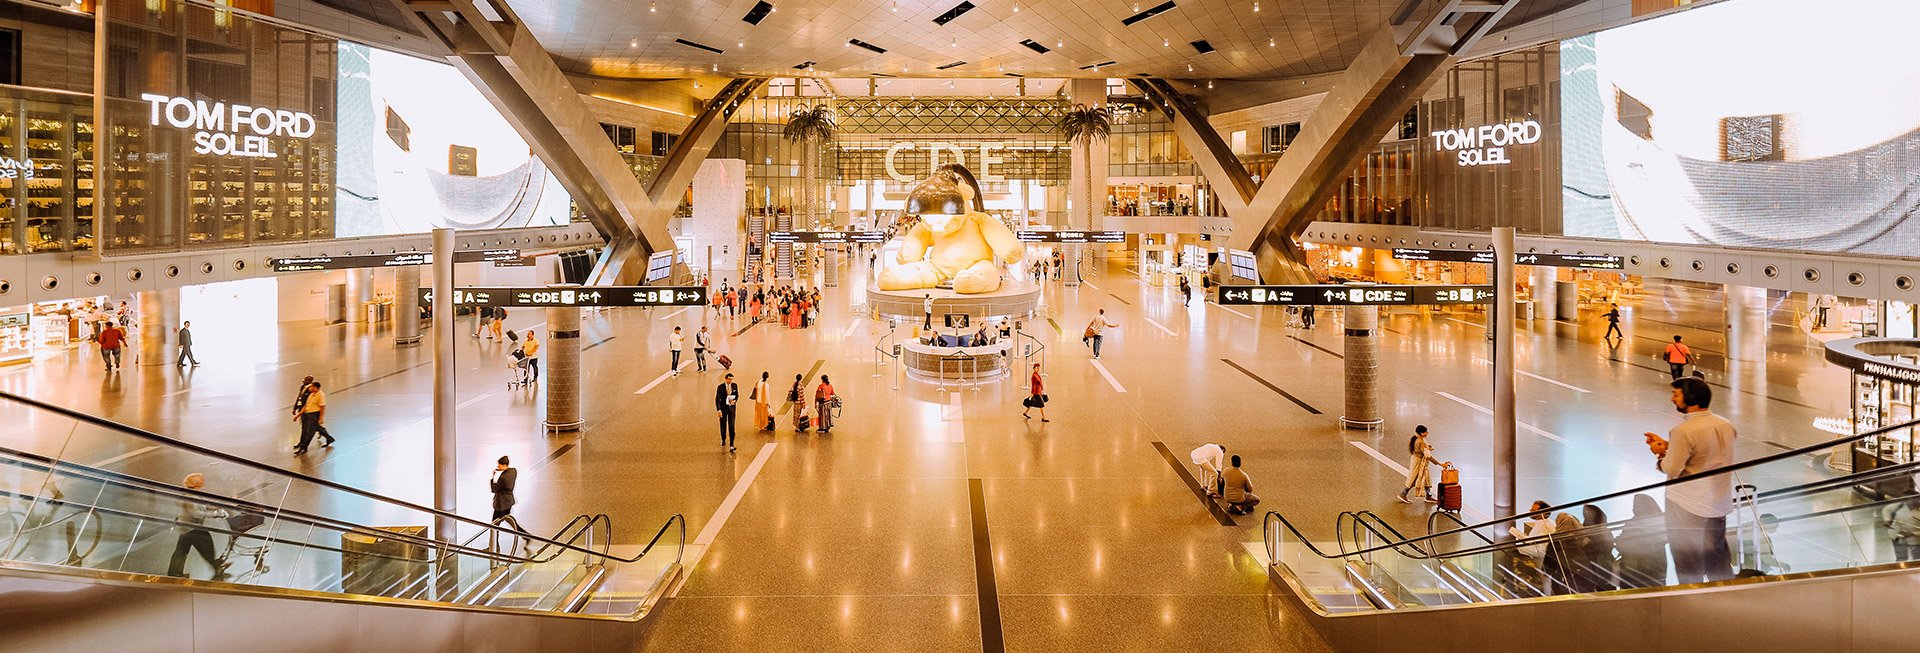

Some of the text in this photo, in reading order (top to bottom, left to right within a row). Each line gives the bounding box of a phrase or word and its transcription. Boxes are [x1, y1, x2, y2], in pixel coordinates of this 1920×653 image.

[142, 93, 316, 139] TOM FORD
[1431, 120, 1542, 151] TOM FORD
[194, 131, 278, 158] SOLEIL
[1457, 147, 1511, 166] SOLEIL
[464, 292, 475, 303] A
[532, 292, 560, 303] CDE
[648, 291, 658, 303] B
[1267, 290, 1278, 302] A
[1365, 290, 1392, 302] CDE
[1449, 290, 1459, 301] B
[1863, 362, 1920, 382] PENHALIGO
